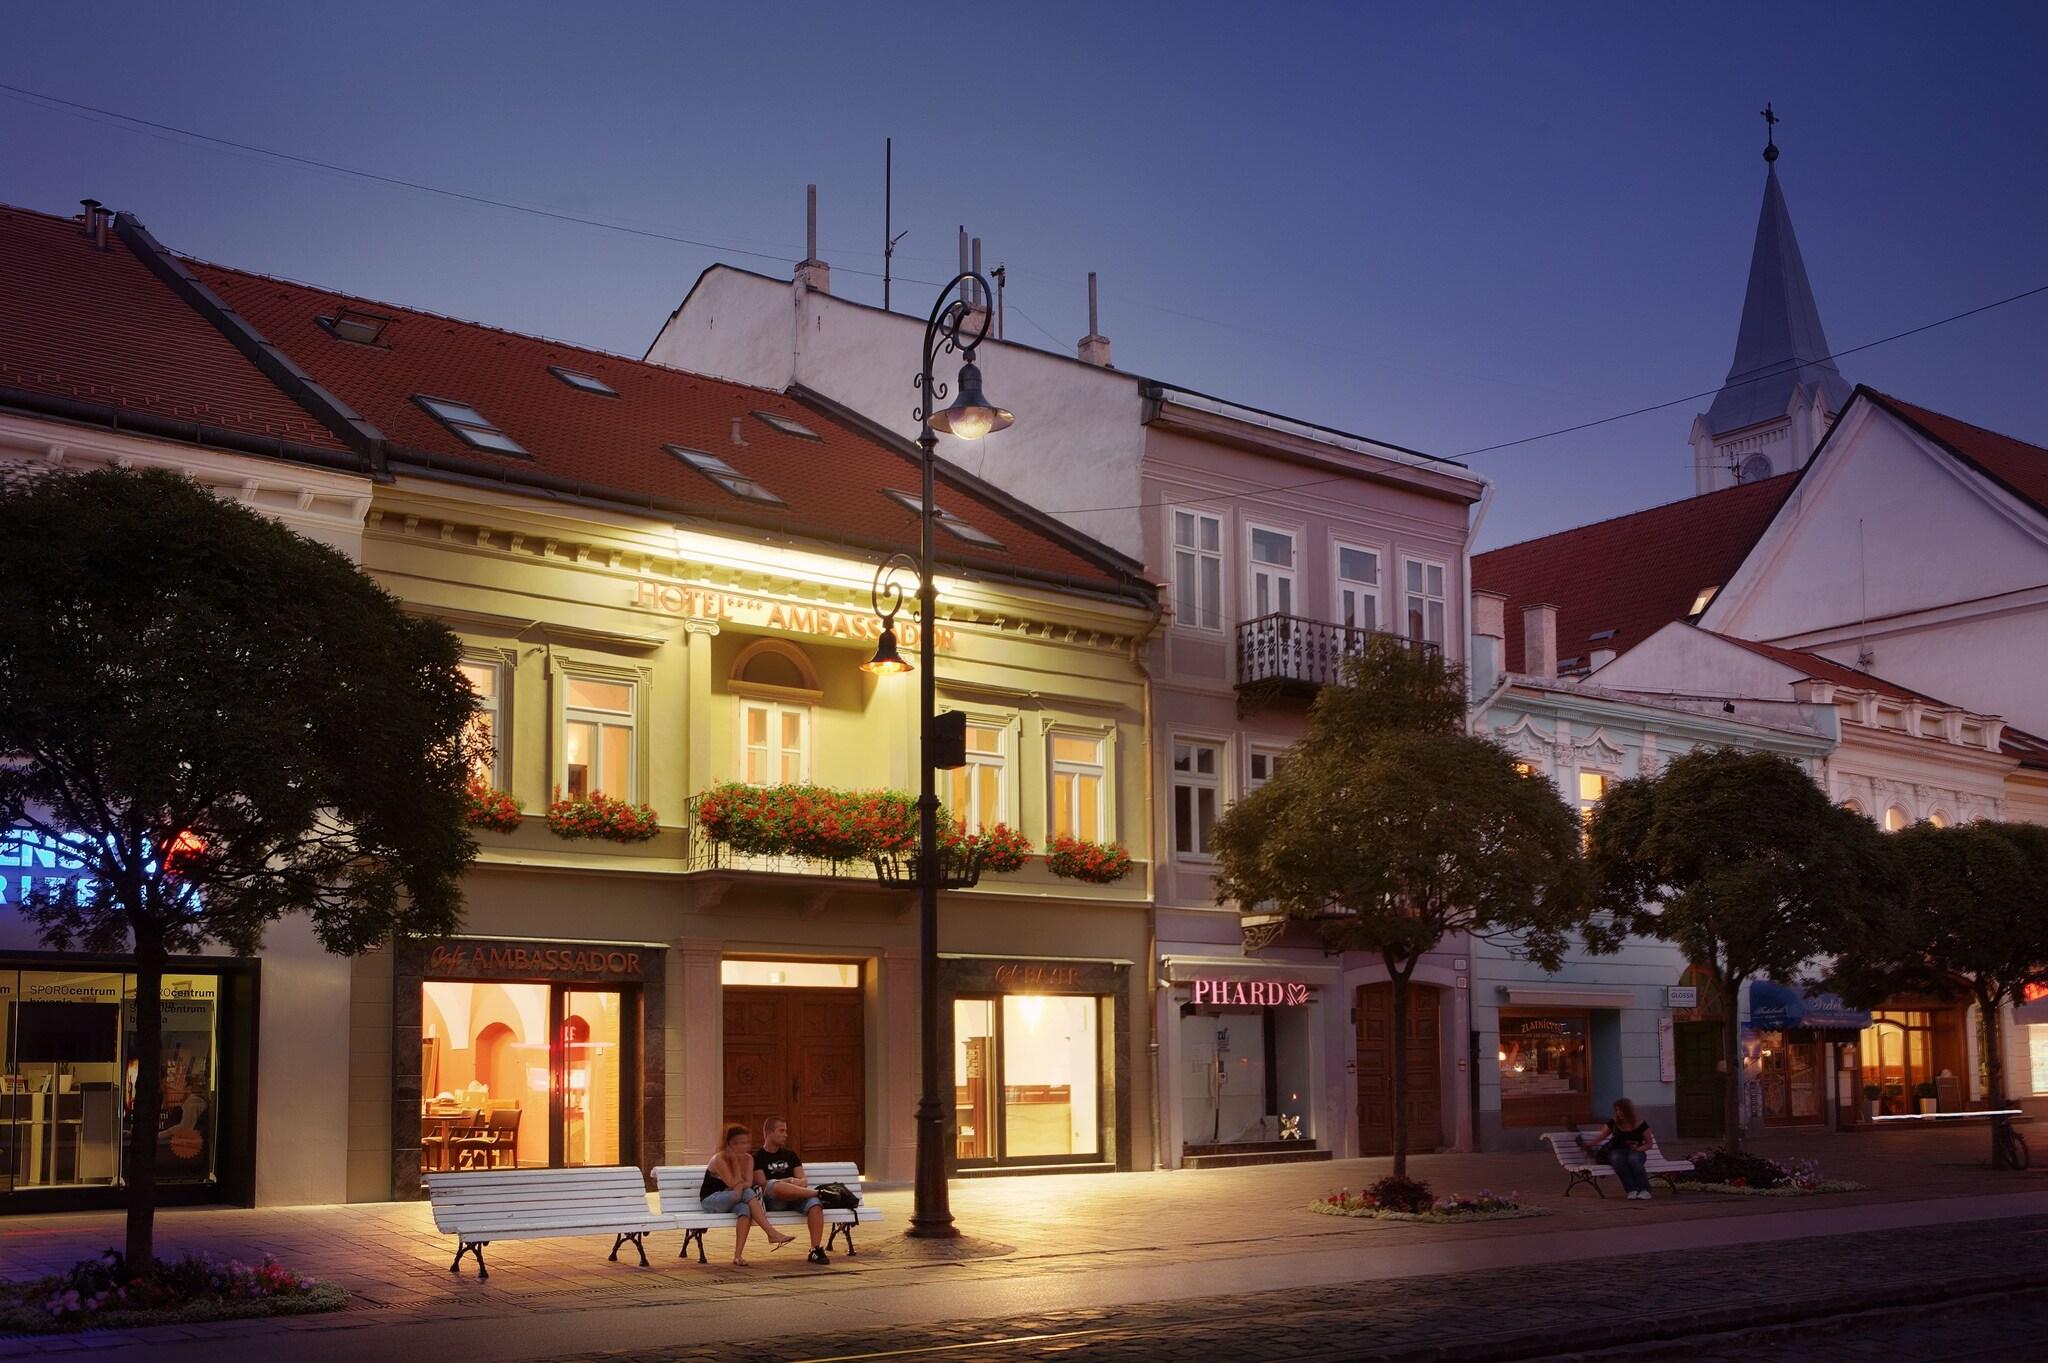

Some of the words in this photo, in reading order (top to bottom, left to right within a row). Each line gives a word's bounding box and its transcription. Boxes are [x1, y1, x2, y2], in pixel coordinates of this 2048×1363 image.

[636, 580, 734, 622] HOTEL
[471, 947, 641, 974] AMBASSADOR
[30, 984, 116, 996] SPOROcentrum
[1190, 980, 1284, 1005] PHARD
